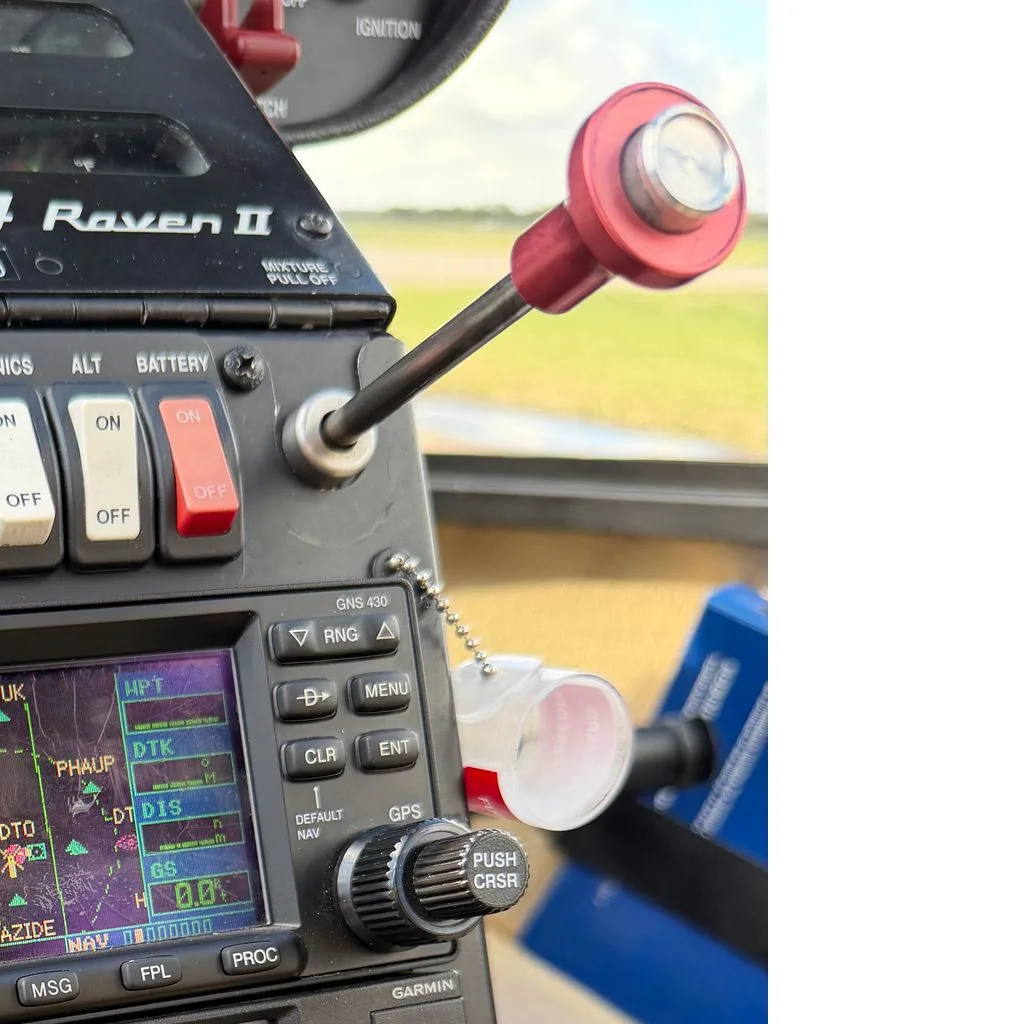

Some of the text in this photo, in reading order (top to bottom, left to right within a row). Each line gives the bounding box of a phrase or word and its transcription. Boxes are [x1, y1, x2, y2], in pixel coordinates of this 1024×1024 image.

[356, 16, 422, 40] IGNITION
[42, 200, 221, 235] Raven
[261, 257, 329, 273] MIXTURE
[267, 273, 338, 286] PULL OFF
[72, 353, 103, 375] ALT
[136, 352, 209, 374] BATTERY
[96, 415, 121, 431] ON
[176, 410, 201, 424] ON
[6, 493, 42, 508] OFF
[193, 484, 227, 500] OFF
[96, 508, 131, 524] OFF
[336, 595, 388, 610] GNS 430
[324, 627, 359, 644] RNG
[365, 681, 409, 699] MENU
[133, 738, 174, 758] DTK
[304, 748, 337, 765] CLR
[379, 740, 410, 757] ENT
[55, 755, 116, 779] PHAUP
[141, 800, 182, 819] DIS
[295, 809, 344, 826] DEFAULT
[388, 804, 423, 823] GPS
[297, 827, 321, 841] NAV
[473, 853, 517, 868] PUSH
[151, 861, 177, 878] GS
[473, 873, 519, 889] CRSR
[0, 919, 58, 942] AZIDE
[68, 934, 109, 952] NAV
[232, 947, 278, 969] PROC
[140, 962, 171, 982] FPL
[31, 978, 73, 999] MSG
[392, 979, 454, 1000] GARMIN
